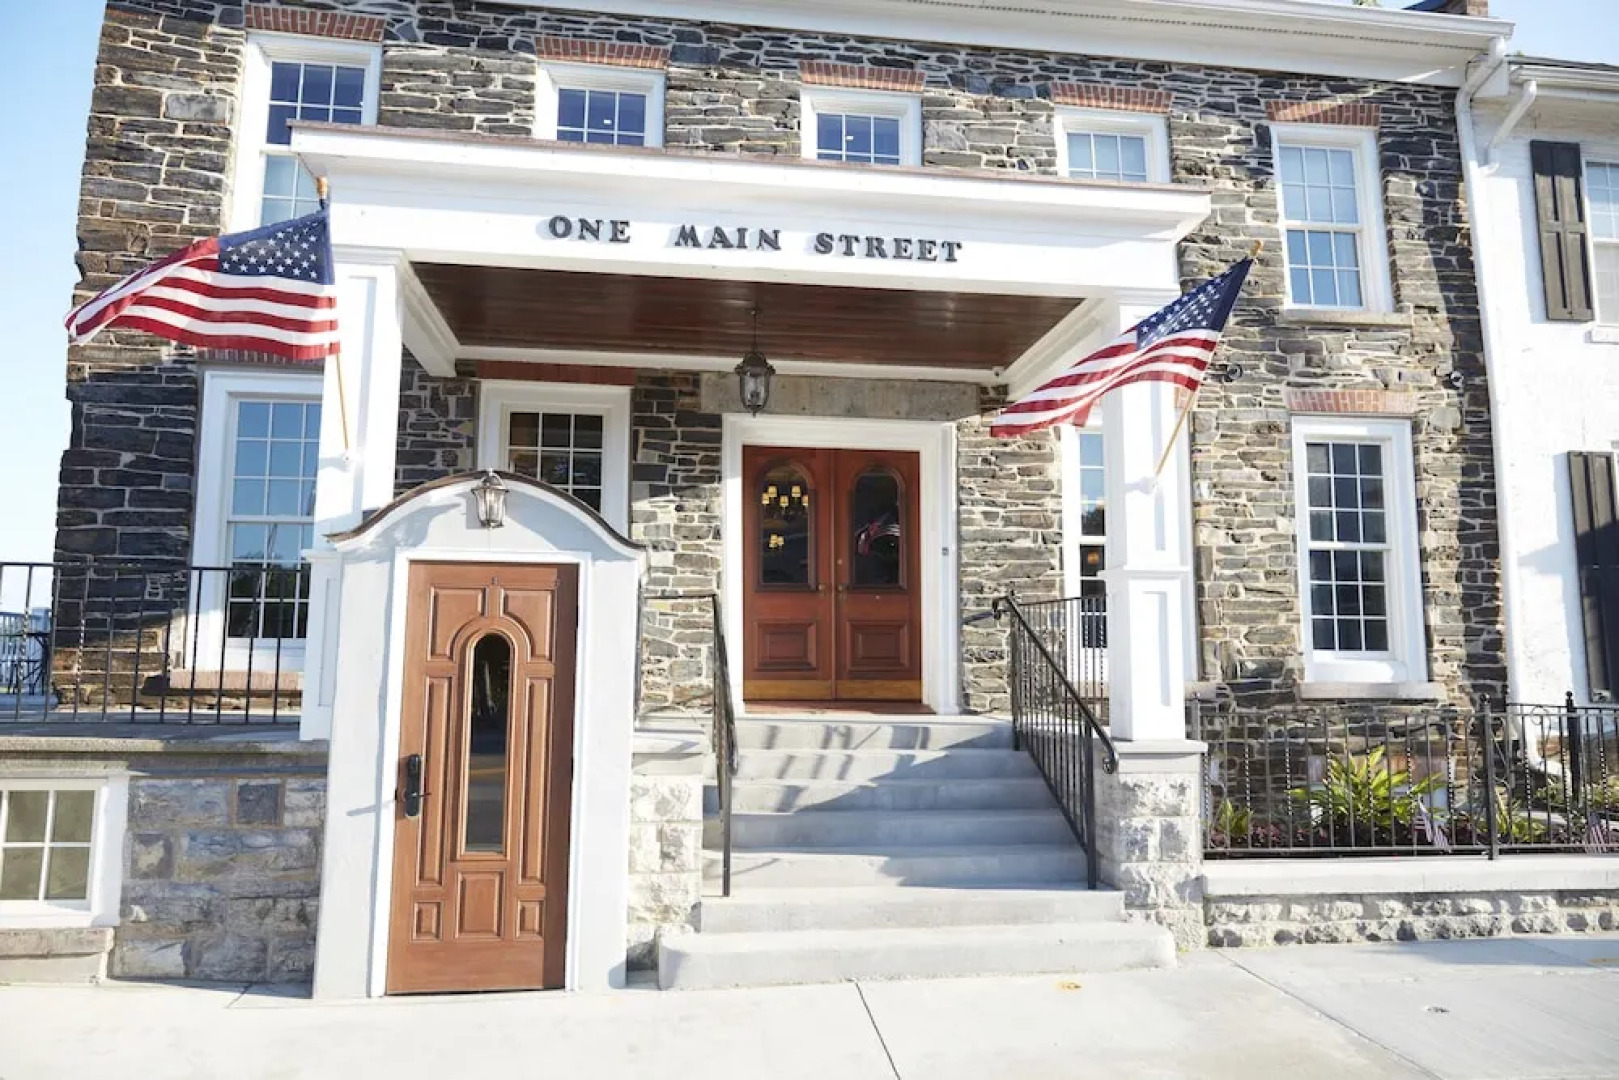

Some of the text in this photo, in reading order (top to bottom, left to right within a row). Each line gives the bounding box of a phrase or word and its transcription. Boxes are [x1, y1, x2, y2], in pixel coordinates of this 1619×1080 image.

[548, 215, 963, 263] ONE MAIN STREET
